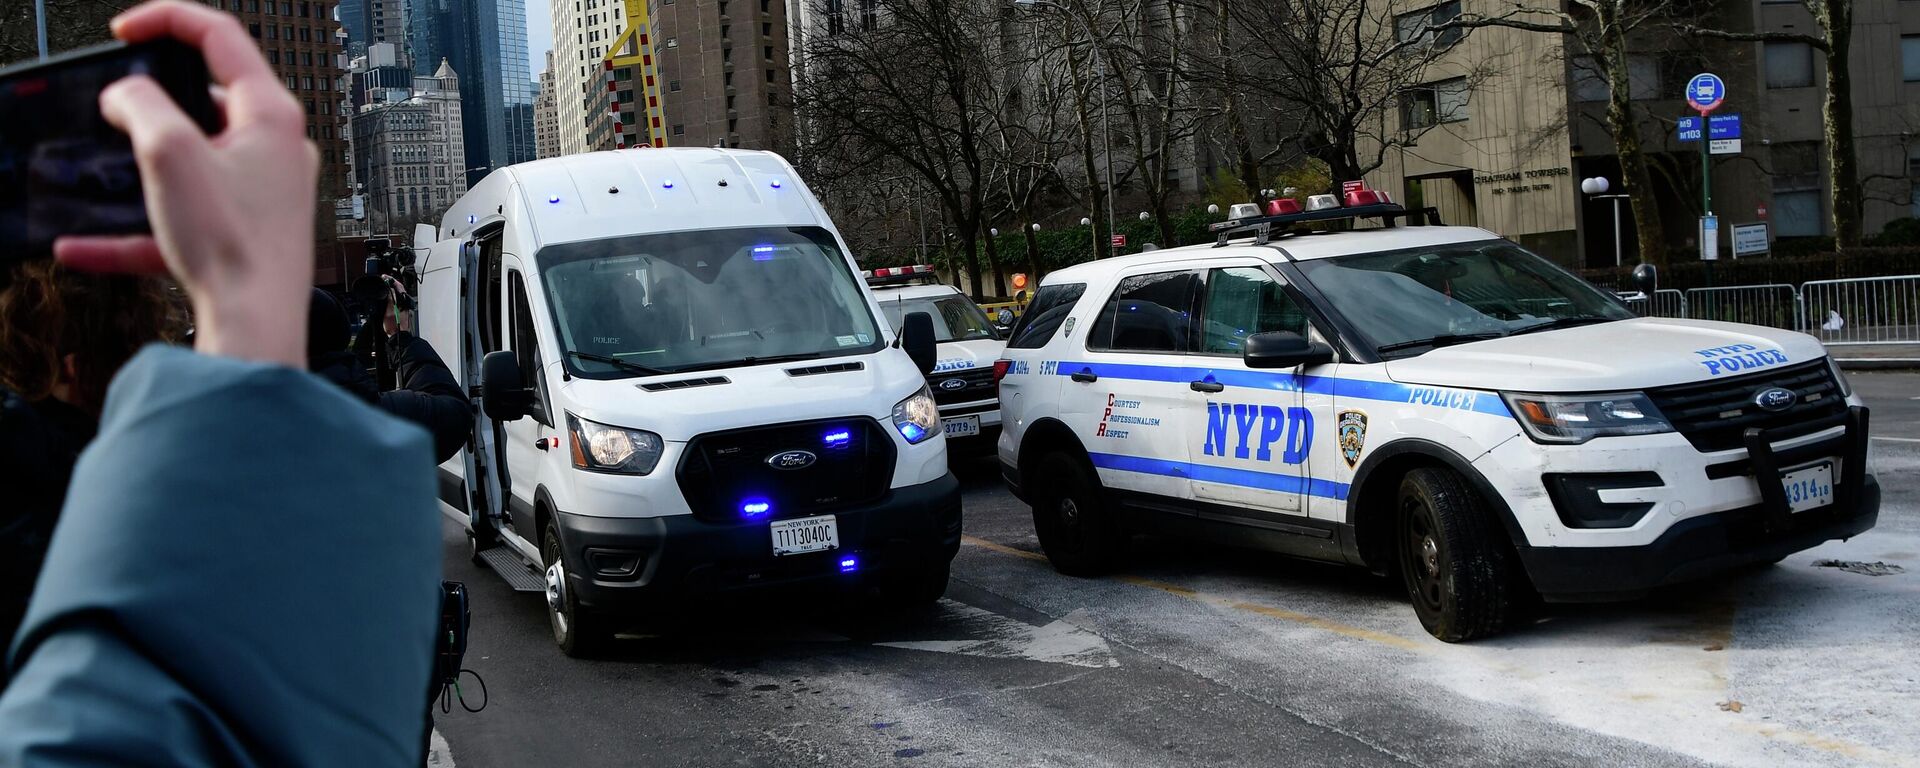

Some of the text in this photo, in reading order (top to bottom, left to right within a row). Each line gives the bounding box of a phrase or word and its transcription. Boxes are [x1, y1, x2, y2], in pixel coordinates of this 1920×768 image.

[1680, 119, 1692, 128] M9
[1680, 130, 1701, 140] M103
[1474, 167, 1569, 184] CHATHAM TOWERS
[593, 336, 621, 344] POLICE
[1695, 344, 1756, 358] NYPD
[934, 361, 975, 371] OLICE
[1039, 361, 1044, 375] 5
[1044, 361, 1057, 375] PCT
[1702, 349, 1788, 375] POLICE
[1410, 388, 1472, 411] POLICE
[1768, 391, 1789, 406] Ford
[945, 422, 968, 433] 3779
[1203, 401, 1314, 464] NYPD
[781, 453, 806, 466] Ford
[777, 524, 832, 547] T113040C
